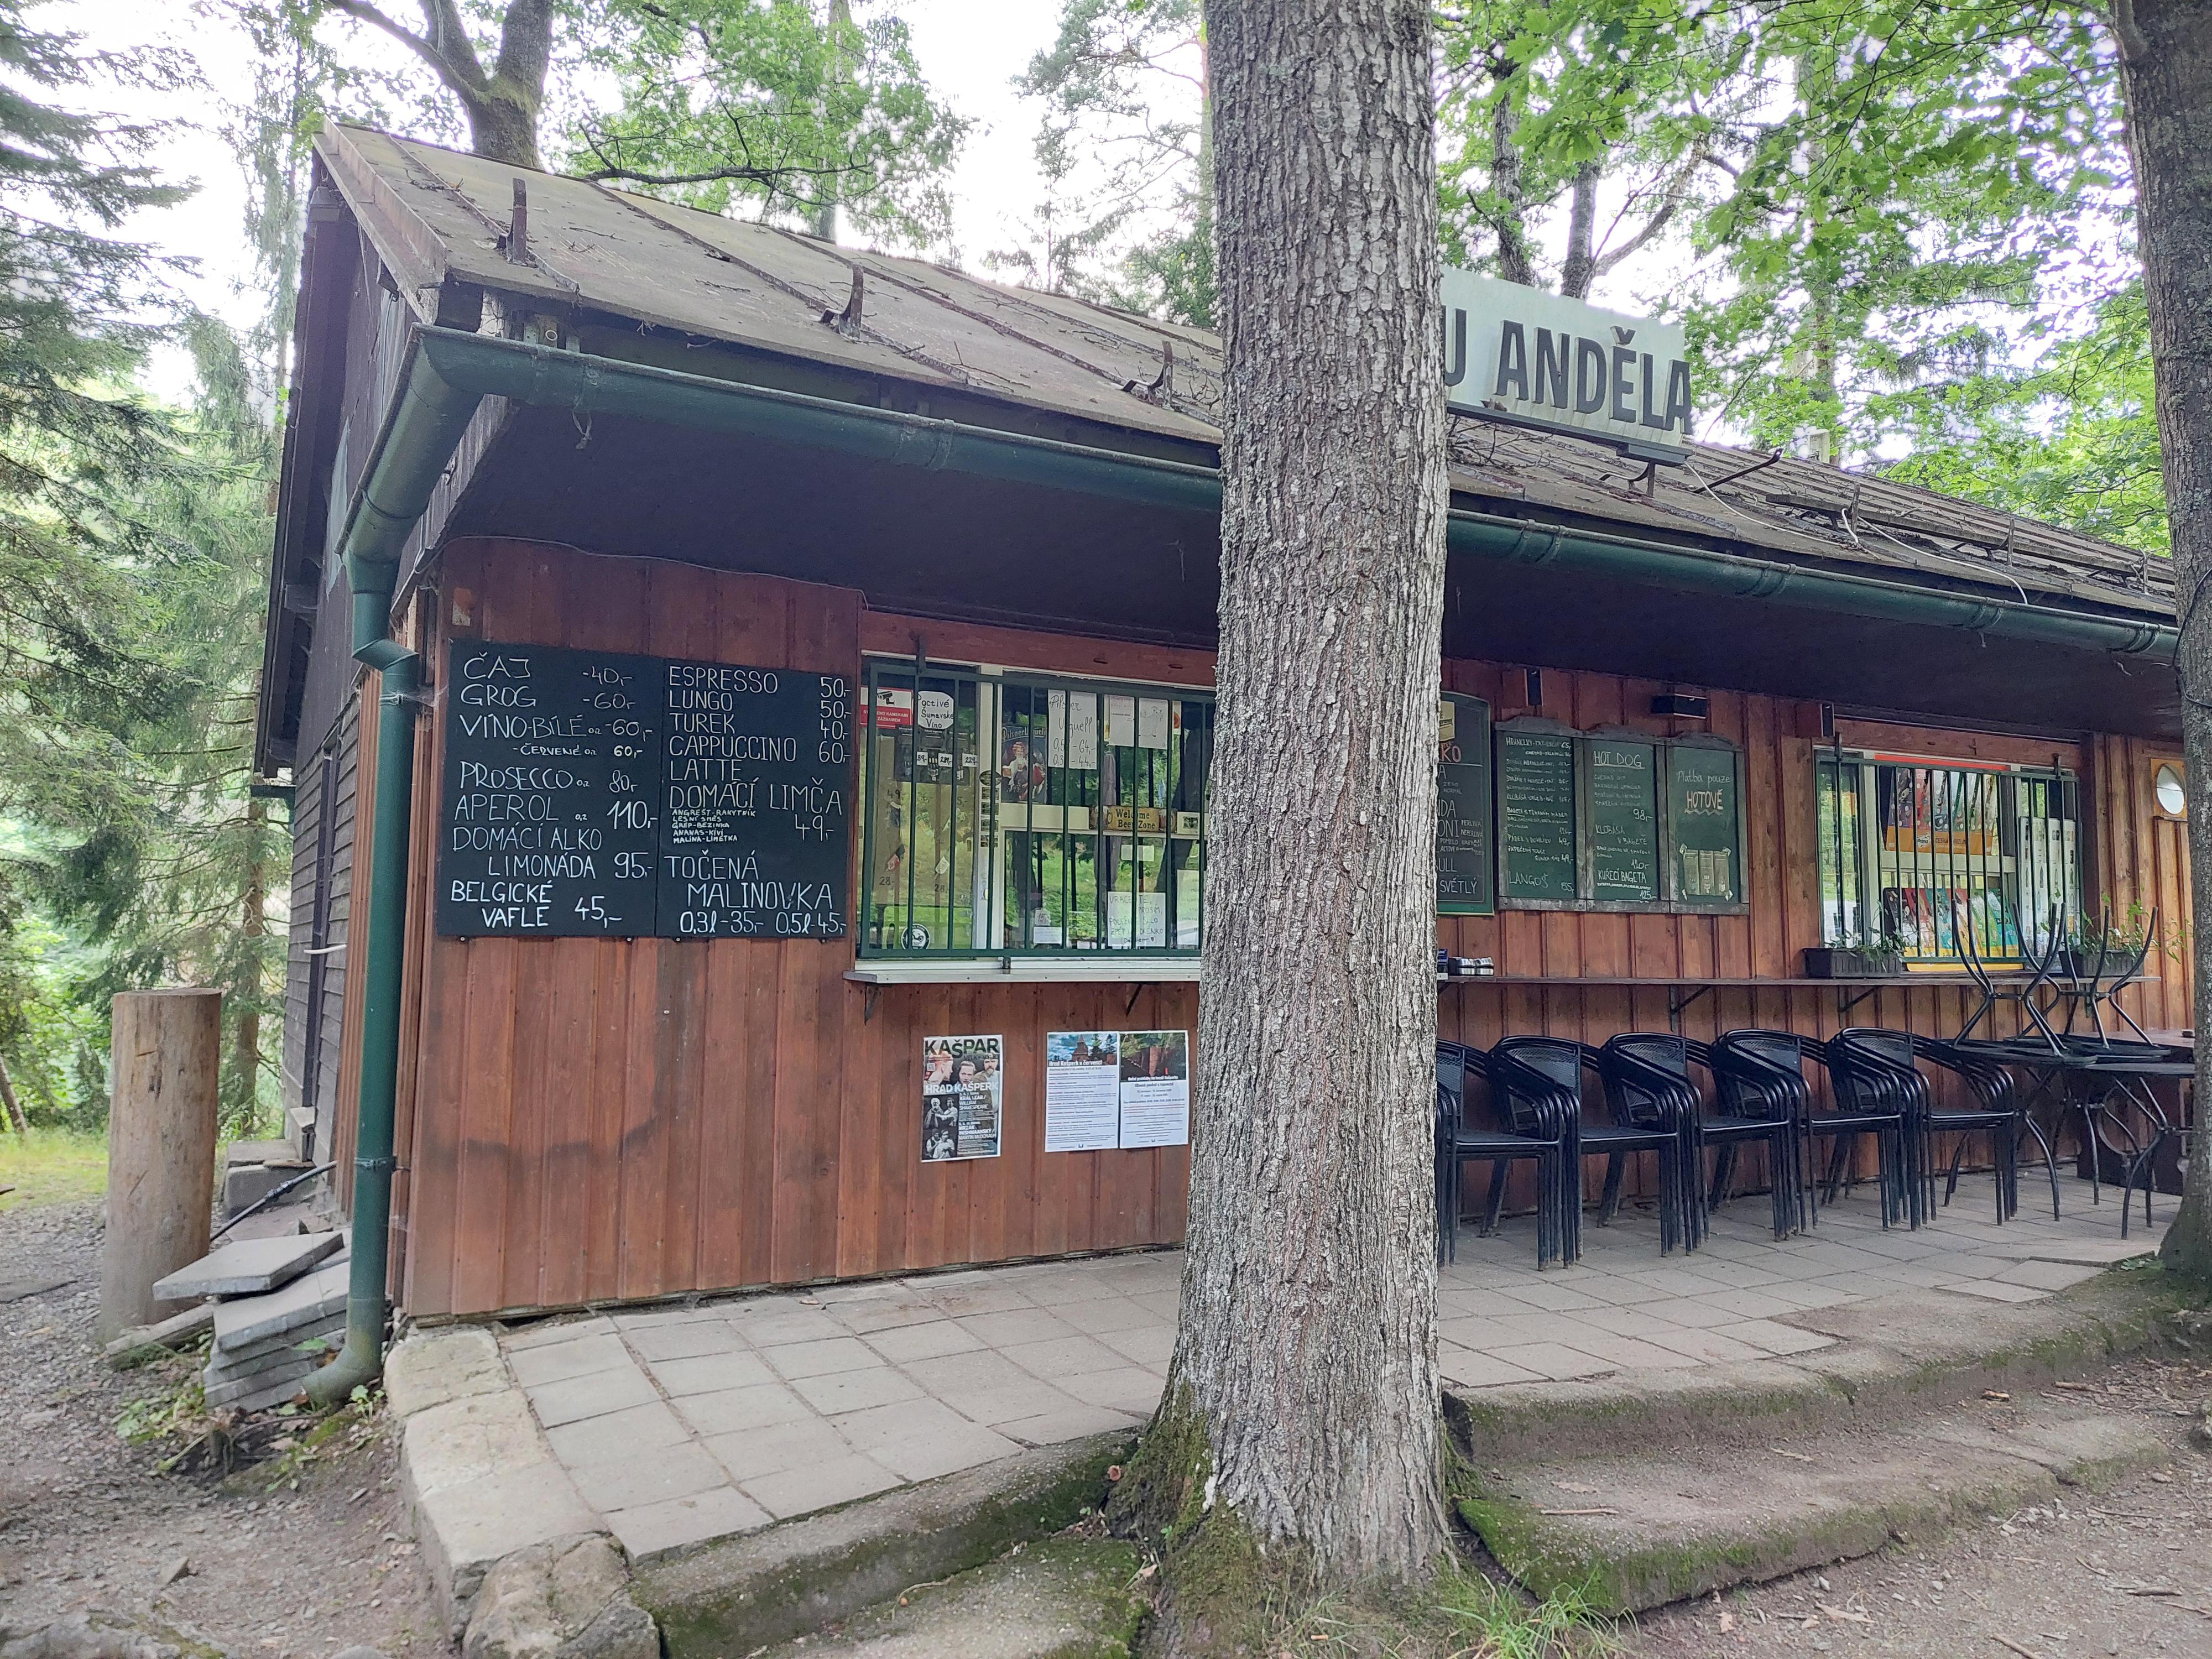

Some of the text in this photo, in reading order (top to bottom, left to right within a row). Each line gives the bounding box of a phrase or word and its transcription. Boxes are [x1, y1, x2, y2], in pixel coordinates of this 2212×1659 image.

[1441, 305, 1693, 435] U ANDĚLA
[463, 651, 531, 679] ČAJ
[669, 666, 779, 693] ESPRESSO
[461, 684, 536, 707] GROG
[669, 690, 733, 712] LUNGO
[1050, 695, 1082, 711] Pilser
[669, 713, 735, 734] TUREK
[669, 736, 797, 761] CAPPUCCINO
[1594, 750, 1641, 768] HOT DOG
[460, 760, 572, 790] PROSECCO
[670, 759, 743, 782] LATTE
[1677, 770, 1731, 788] Platba pouze
[669, 777, 842, 816] DOMÁCÍ LIMČA
[1686, 789, 1724, 811] HOTOVĚ
[454, 794, 559, 821] APEROL
[606, 800, 658, 830] 110,-
[1115, 808, 1150, 820] Welme
[1118, 819, 1156, 830] Bee Zone
[453, 822, 602, 852] DOMÁCÍ ALKO
[488, 852, 654, 879] LIMONÁDA 95,-
[664, 849, 759, 880] TOČENÁ
[1598, 868, 1647, 884] KUŘECÍ BAGETA
[1439, 877, 1477, 894] SVĚTLÝ
[1509, 870, 1548, 889] LANGOŠ
[451, 880, 554, 904] BELGICKÉ
[687, 883, 832, 910] MALINOVKA
[482, 895, 622, 928] VAFLE 45,-
[925, 1038, 1000, 1058] KAŠPAR
[925, 1081, 999, 1094] HRAD KAŠPERK
